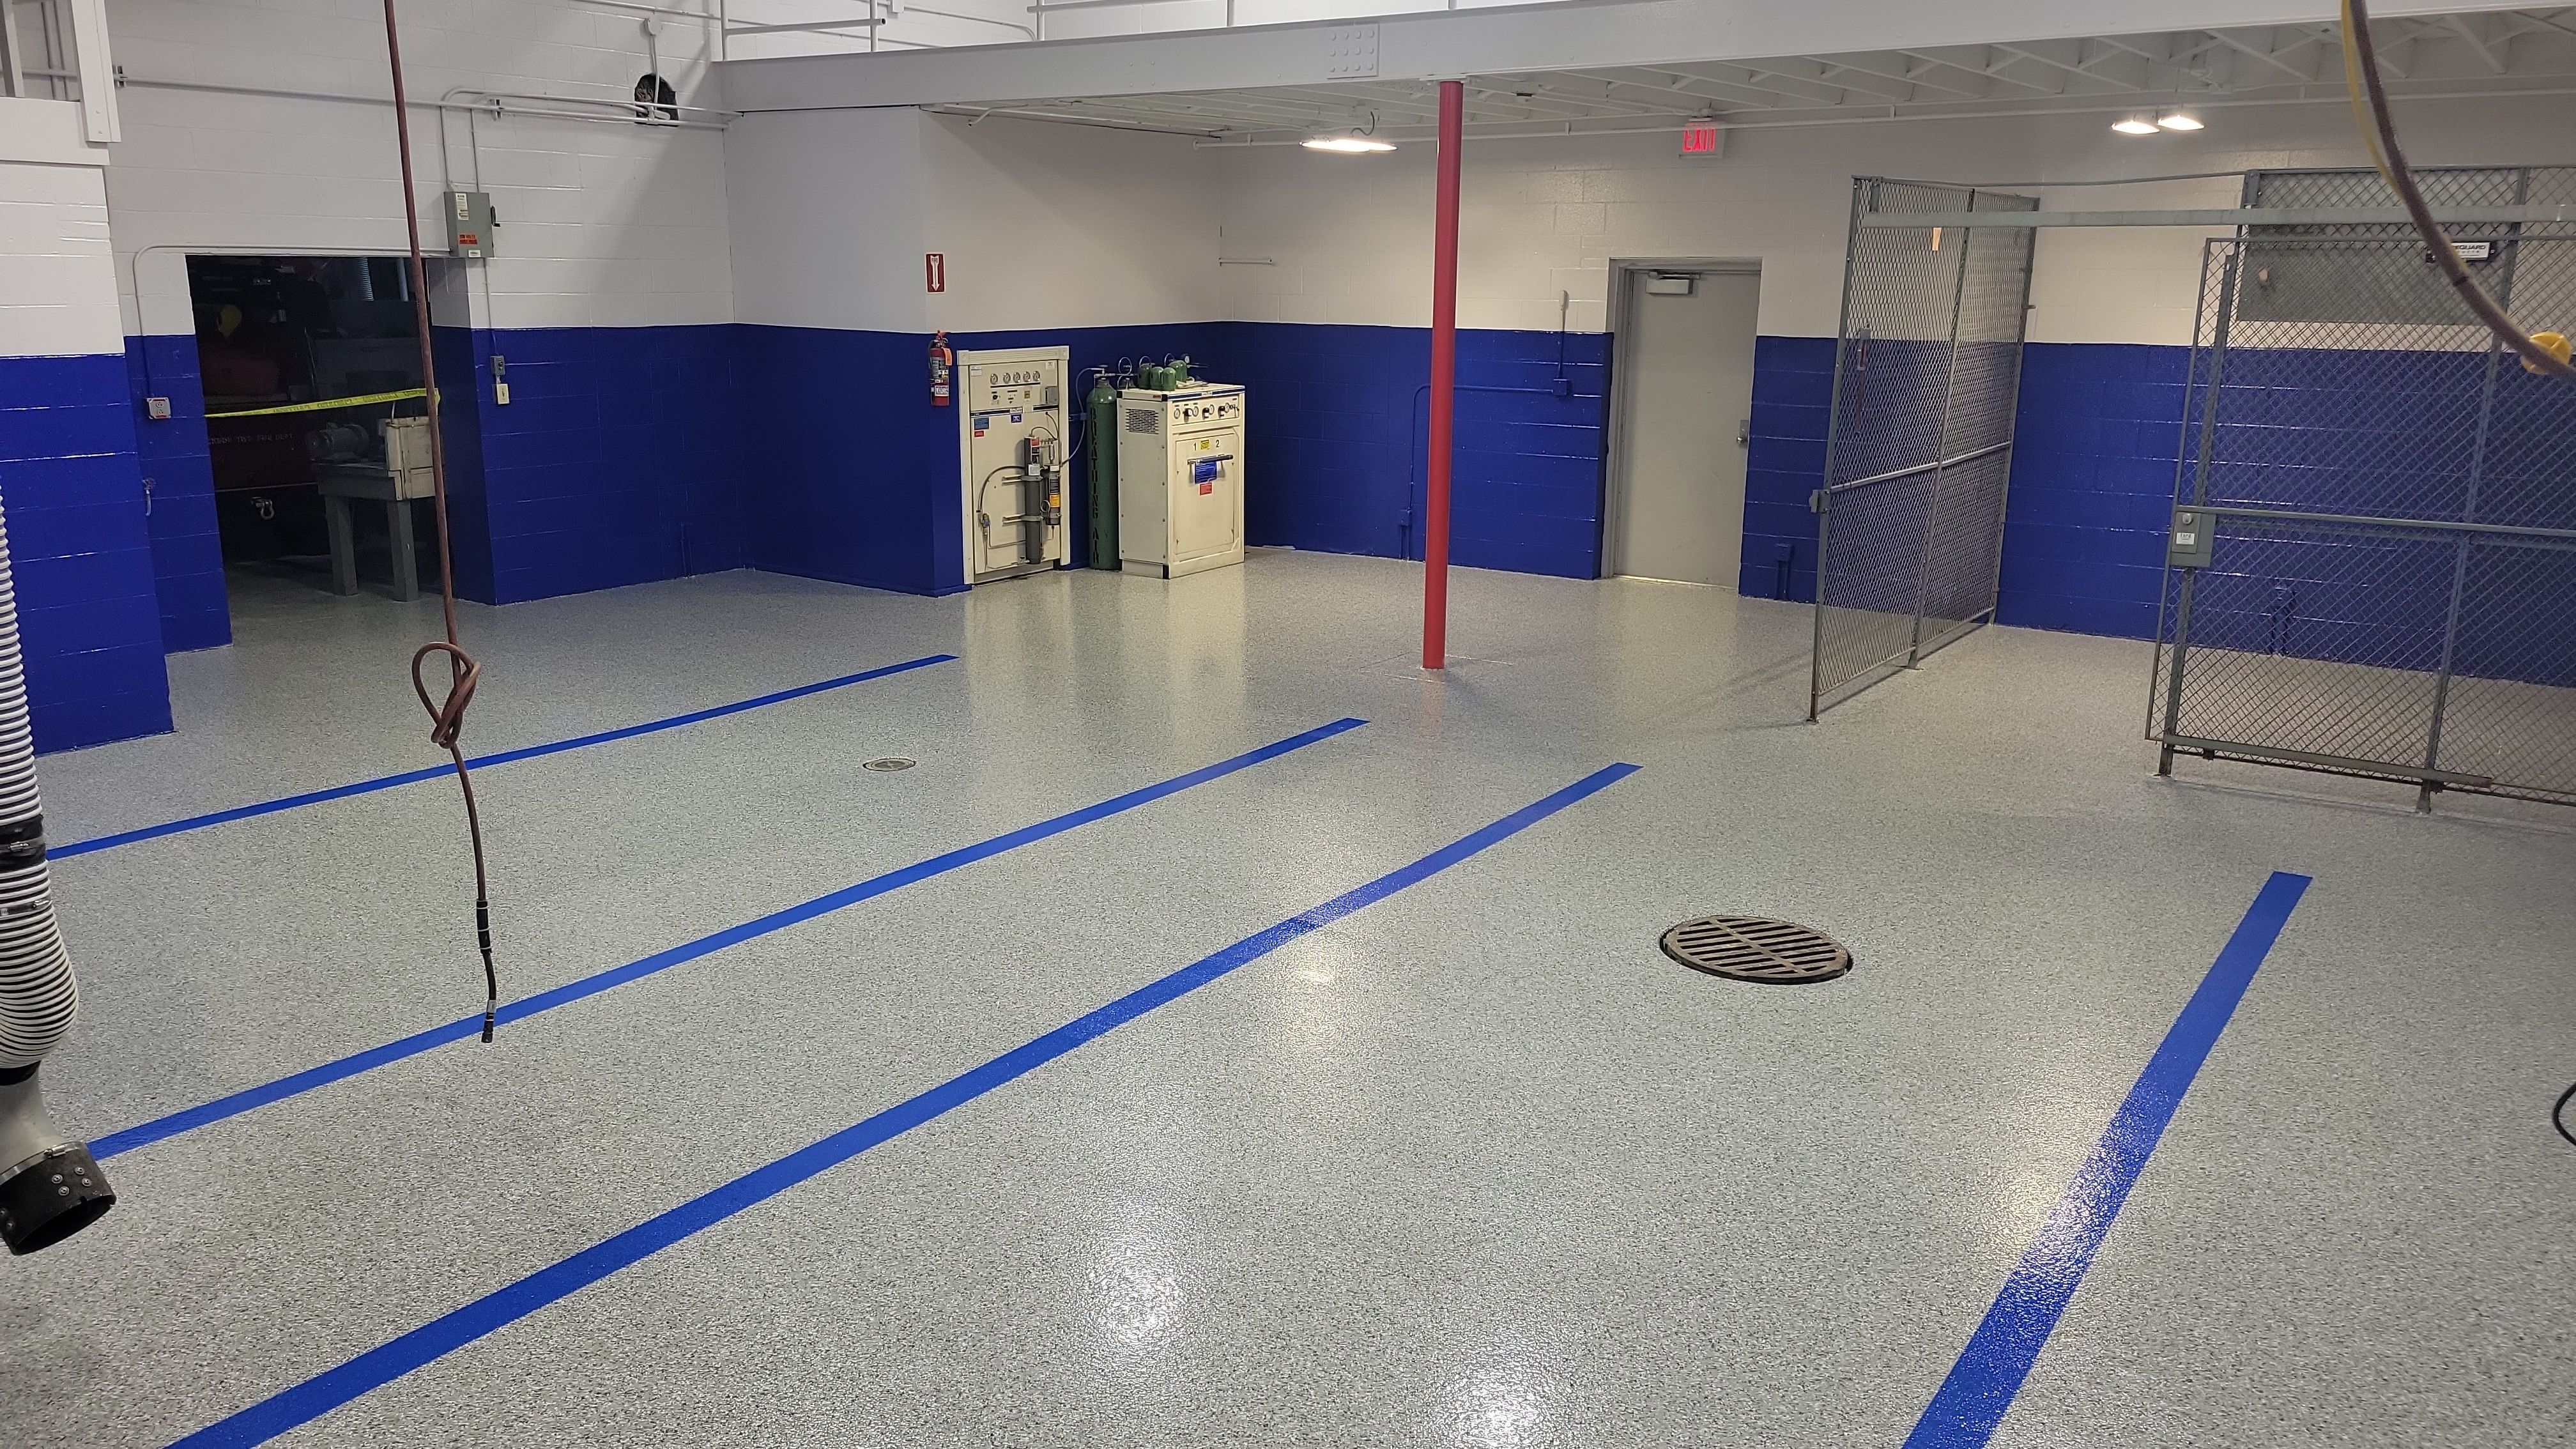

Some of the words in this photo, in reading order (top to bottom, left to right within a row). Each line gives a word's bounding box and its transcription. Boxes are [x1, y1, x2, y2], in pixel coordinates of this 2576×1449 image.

[1683, 128, 1716, 152] EXIT
[1193, 442, 1197, 451] 1
[1215, 439, 1220, 448] 2
[1090, 407, 1099, 519] BREATHING
